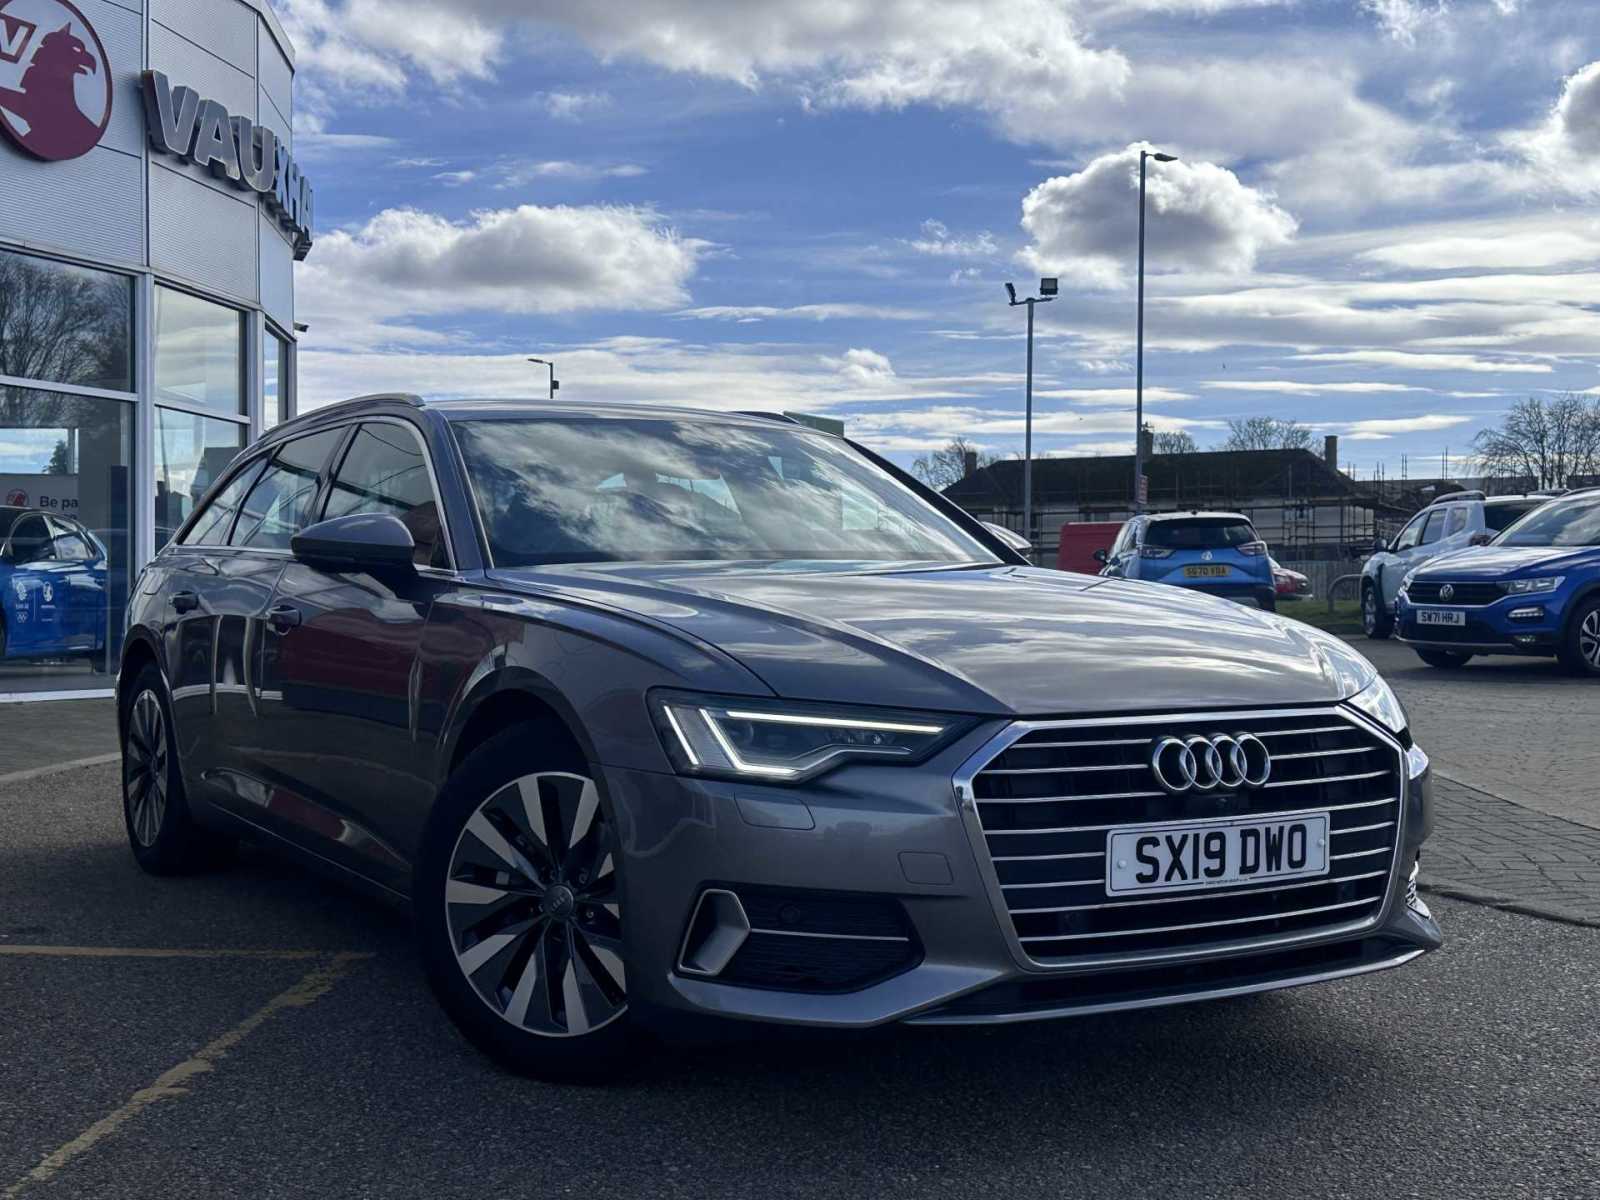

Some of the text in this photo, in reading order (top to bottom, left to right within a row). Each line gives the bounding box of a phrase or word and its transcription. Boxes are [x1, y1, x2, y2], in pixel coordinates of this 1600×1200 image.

[40, 495, 58, 508] Be
[1421, 611, 1460, 623] SW71 HRJ
[1135, 823, 1307, 884] SX19 DWO
